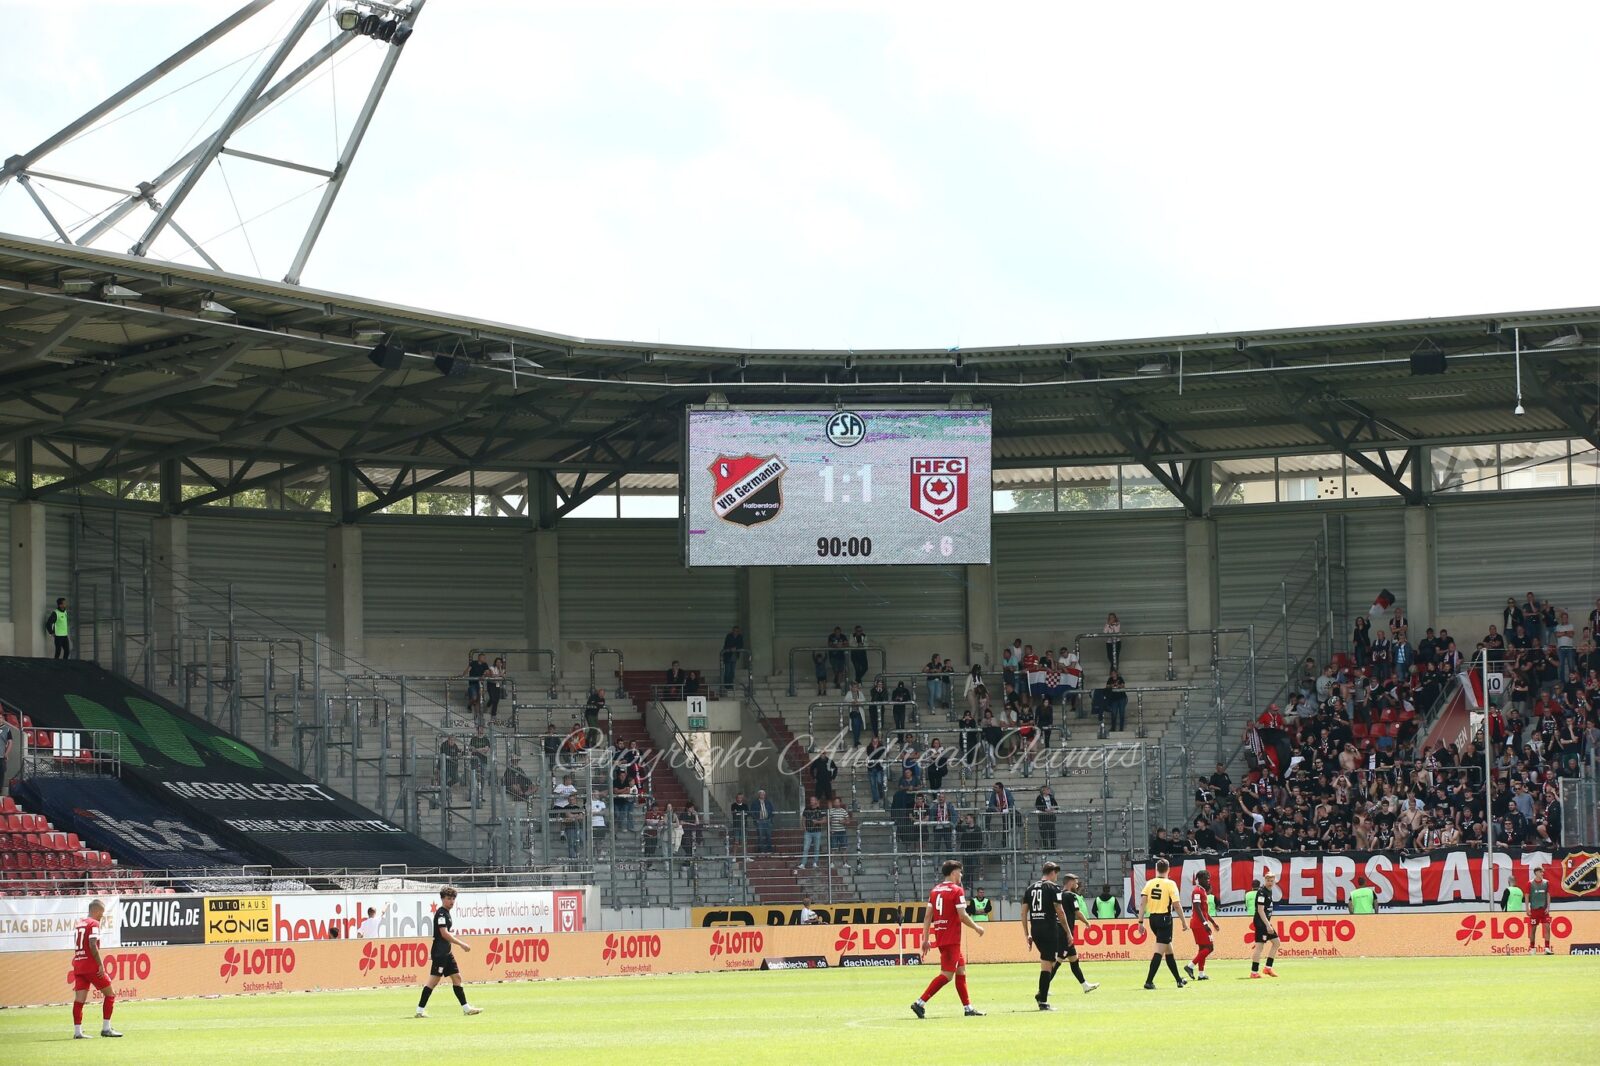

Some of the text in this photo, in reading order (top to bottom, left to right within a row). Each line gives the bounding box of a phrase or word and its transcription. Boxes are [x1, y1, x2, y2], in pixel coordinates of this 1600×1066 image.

[829, 414, 862, 436] FSA
[915, 460, 962, 473] HFC
[735, 461, 781, 498] Germania
[818, 464, 873, 503] 1:1
[817, 537, 872, 557] 90:00
[940, 535, 952, 557] 6
[691, 701, 702, 713] 11
[162, 782, 335, 801] MOBILEBET
[224, 819, 278, 831] DEINE
[456, 899, 550, 918] hunderte wirklich tolle
[560, 900, 575, 909] HFC
[935, 893, 943, 916] 4
[1031, 889, 1043, 911] 29
[33, 918, 54, 932] DER
[210, 915, 269, 934] KÖNIG
[1074, 924, 1148, 945] LOTTO
[1277, 920, 1356, 943] LOTTO
[505, 938, 550, 963] LOTTO
[620, 934, 661, 958] LOTTO
[726, 931, 764, 954] LOTTO
[1277, 948, 1338, 957] Sachsen-Anhalt
[243, 948, 296, 975] LOTTO
[380, 943, 429, 969] LOTTO
[1078, 951, 1131, 960] achsen-Anhalt
[103, 953, 151, 981] OTTO
[504, 969, 540, 979] Sachsen-Anhalt
[620, 964, 652, 973] Sachsen-Anhalt
[243, 981, 284, 992] Sachsen-Anhalt
[379, 975, 418, 985] Sachsen-Anhalt
